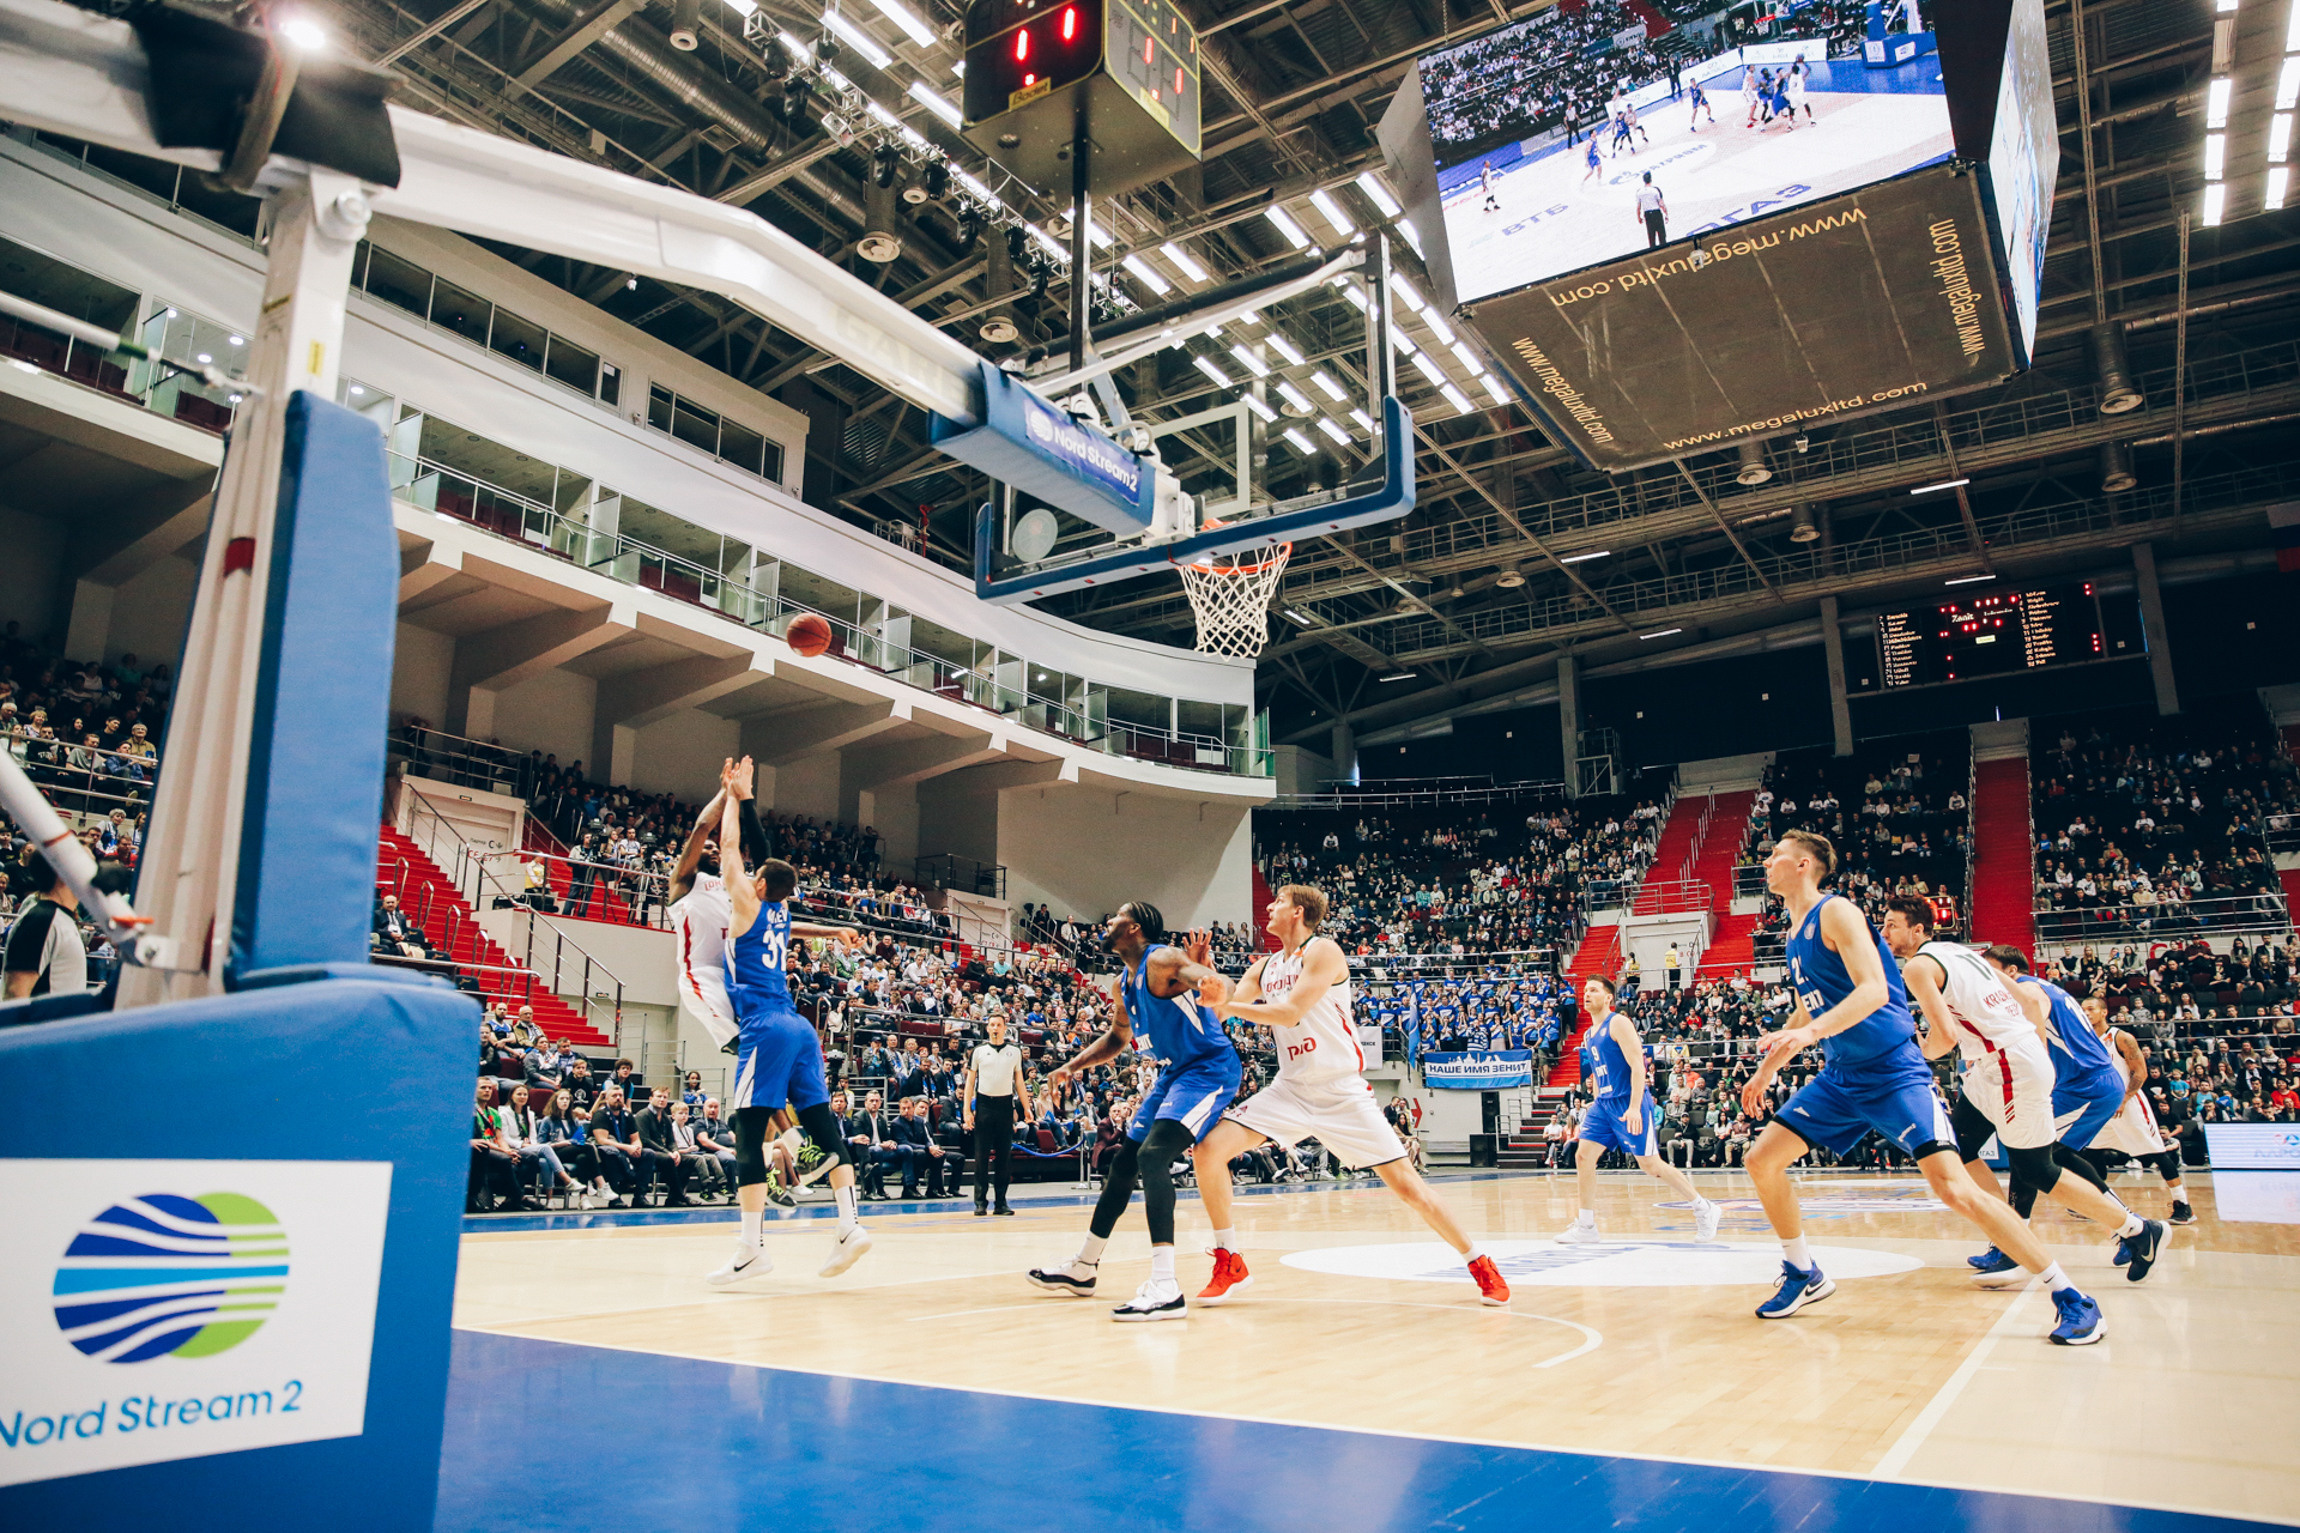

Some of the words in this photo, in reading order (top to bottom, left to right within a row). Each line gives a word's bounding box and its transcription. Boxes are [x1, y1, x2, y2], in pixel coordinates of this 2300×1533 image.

[1929, 218, 1985, 356] www.megaluxltd.com
[1512, 336, 1615, 444] www.megaluxltd.com
[1664, 382, 1927, 449] www.megaluxltd.com
[1054, 426, 1087, 460] Nord
[1088, 445, 1130, 487] Stream
[1129, 474, 1138, 492] 2
[762, 929, 787, 972] 31
[1429, 1064, 1462, 1074] НАШЕ
[1464, 1064, 1490, 1074] ИМЯ
[1492, 1062, 1527, 1074] ЗЕНИТ
[1591, 1045, 1600, 1062] 9
[0, 1401, 108, 1449] Nord
[116, 1389, 273, 1434] Stream
[280, 1379, 304, 1413] 2
